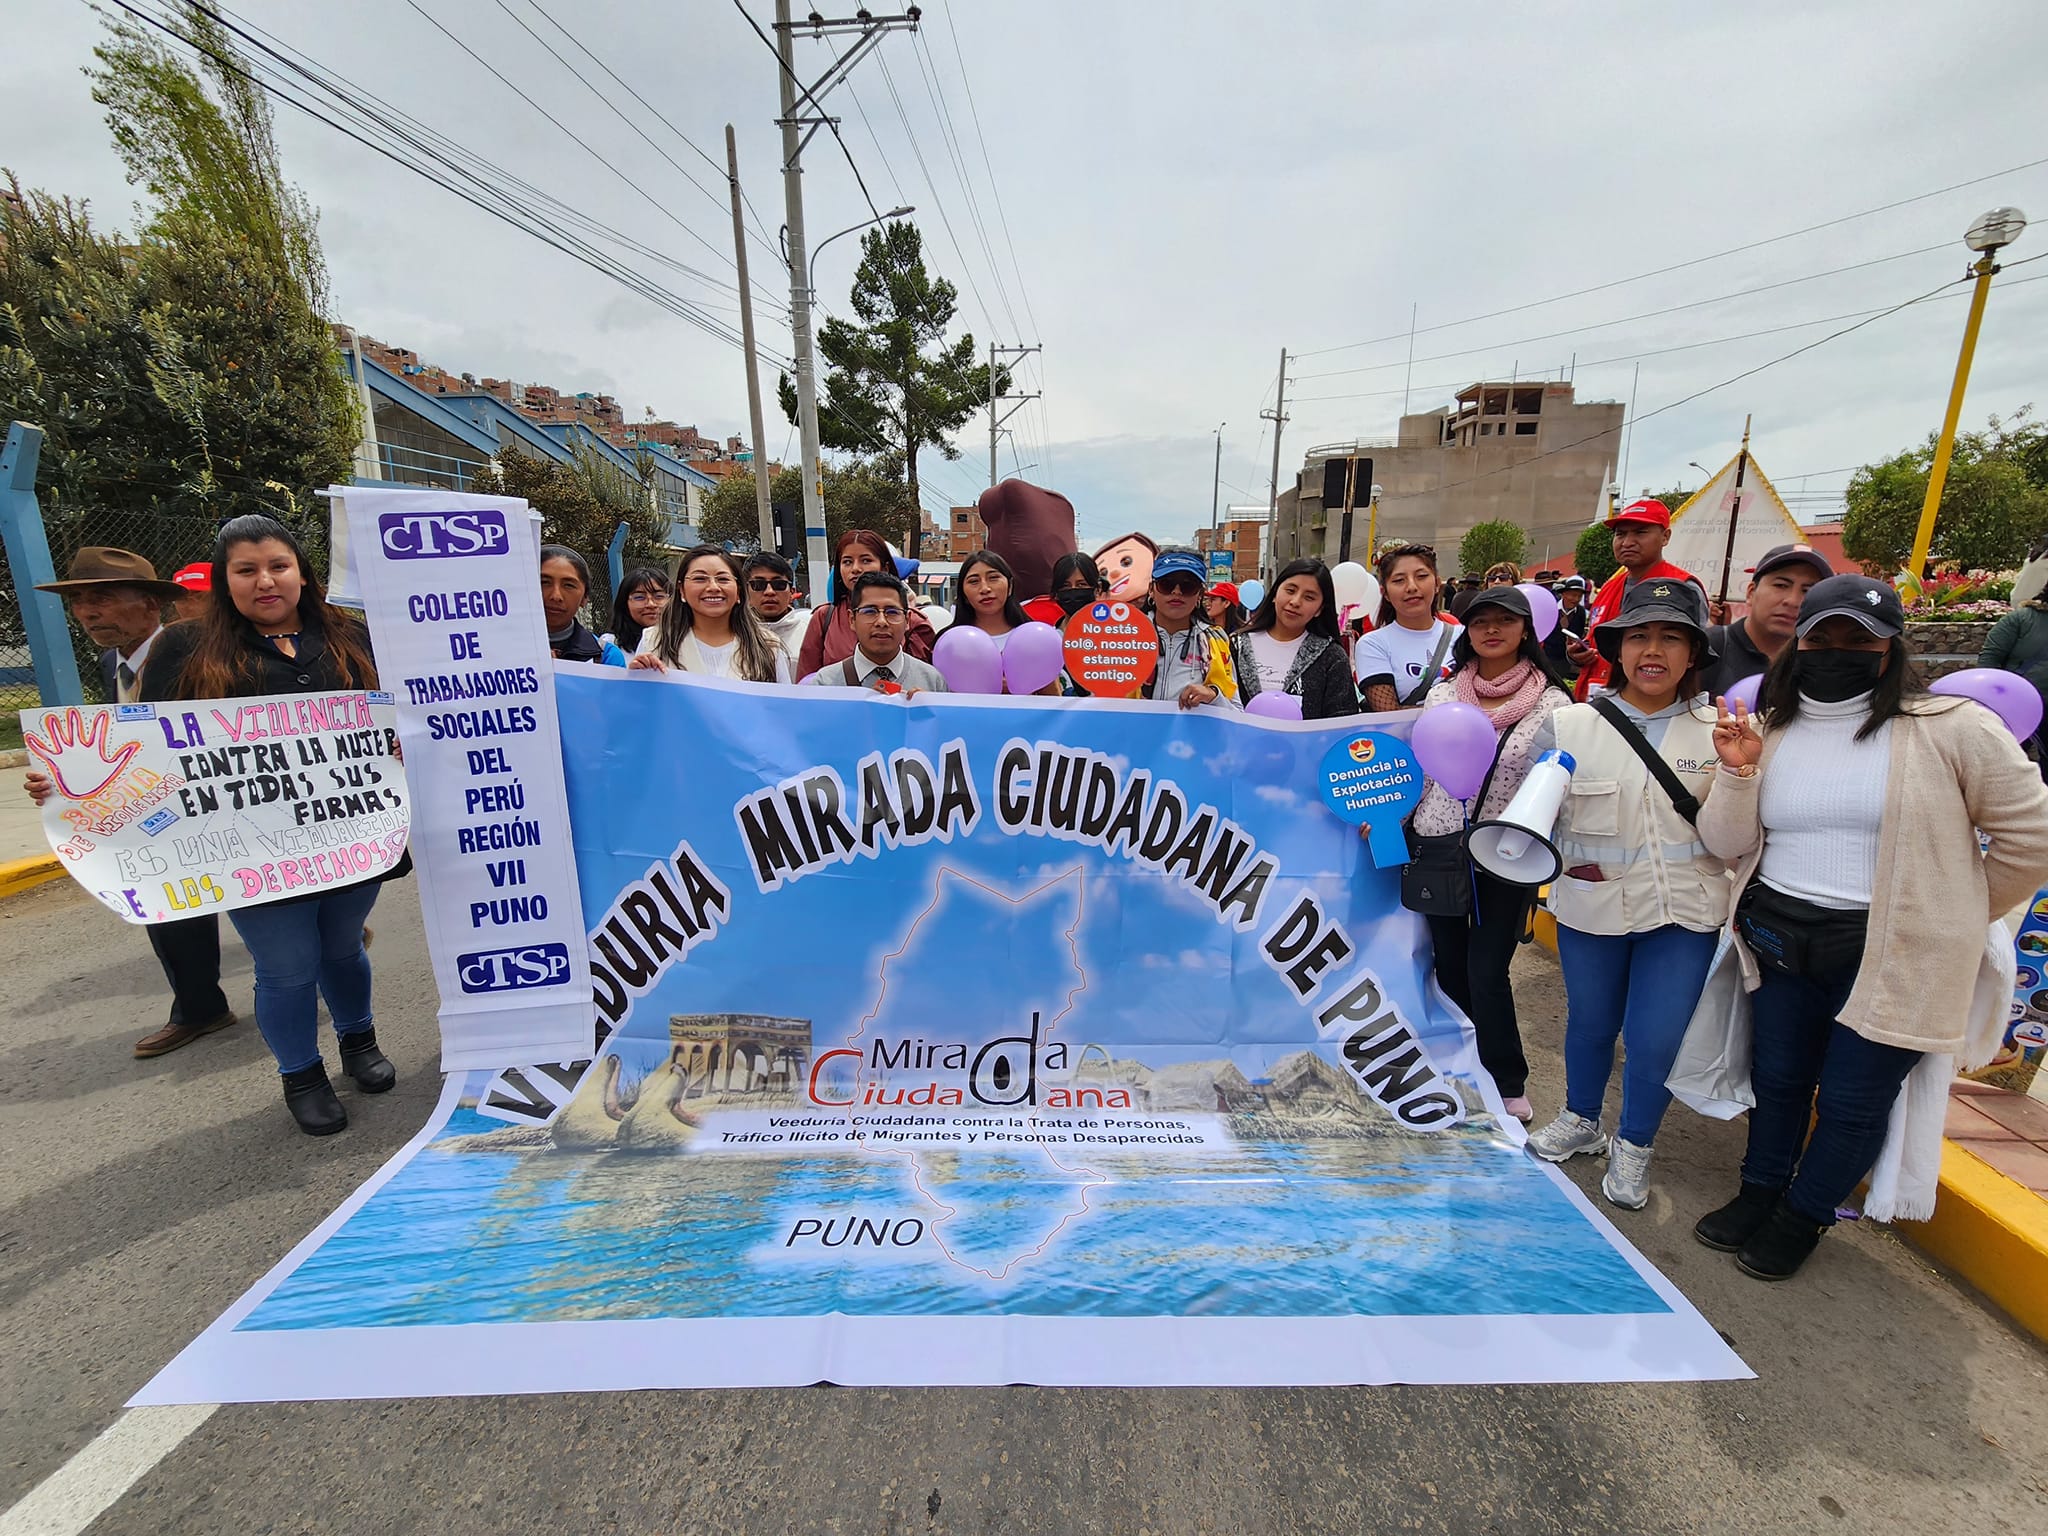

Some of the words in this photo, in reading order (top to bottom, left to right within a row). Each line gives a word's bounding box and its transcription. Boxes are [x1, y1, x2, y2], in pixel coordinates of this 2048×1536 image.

[408, 589, 509, 622] COLEGIO
[1064, 638, 1097, 650] sol@,
[1101, 640, 1156, 650] nosotros
[1083, 623, 1101, 633] No
[1104, 623, 1138, 634] estás
[449, 632, 482, 660] DE
[1083, 654, 1138, 665] estamos
[404, 667, 539, 705] TRABAJADORES
[1084, 669, 1137, 683] contigo.
[159, 712, 206, 748] LA
[211, 694, 374, 742] VIOLENCIA
[427, 706, 537, 740] SOCIALES
[178, 742, 290, 781] CONTRA
[296, 737, 328, 766] LA
[467, 747, 512, 775] DEL
[1394, 757, 1407, 769] la
[1676, 758, 1697, 769] CHS
[59, 767, 161, 832] BASTA
[178, 784, 219, 818] EN
[224, 771, 315, 810] TODAS
[329, 761, 382, 789] SUS
[465, 777, 525, 814] PERÚ
[1331, 772, 1412, 797] Explotación
[1345, 791, 1406, 810] Humana.
[293, 787, 403, 826] FORMAS
[57, 835, 96, 861] DE
[115, 845, 168, 883] ES
[172, 828, 250, 867] UNA
[256, 807, 410, 858] VIOLACION
[457, 816, 541, 853] REGIÓN
[98, 888, 148, 917] DE
[162, 873, 224, 911] LOS
[232, 837, 388, 899] DERECHOS
[486, 859, 527, 888] VII
[470, 894, 548, 928] PUNO
[739, 748, 975, 879] MIRADA
[1000, 747, 1274, 923] CIUDADANA
[1264, 898, 1351, 996] DE
[1319, 977, 1458, 1104] PUNO
[722, 1131, 783, 1142] Tráfico
[789, 1131, 839, 1142] Ilícito
[845, 1130, 867, 1141] de
[872, 1130, 961, 1142] Migrantes
[967, 1133, 979, 1143] y
[984, 1130, 1068, 1143] Personas
[1073, 1132, 1205, 1146] Desaparecidas
[769, 1117, 846, 1127] Veeduría
[852, 1115, 946, 1126] Ciudadana
[952, 1118, 1003, 1127] contra
[1009, 1117, 1023, 1127] la
[1030, 1117, 1073, 1128] Trata
[1078, 1118, 1099, 1129] de
[1104, 1118, 1191, 1131] Personas,
[786, 1216, 924, 1248] PUNO
